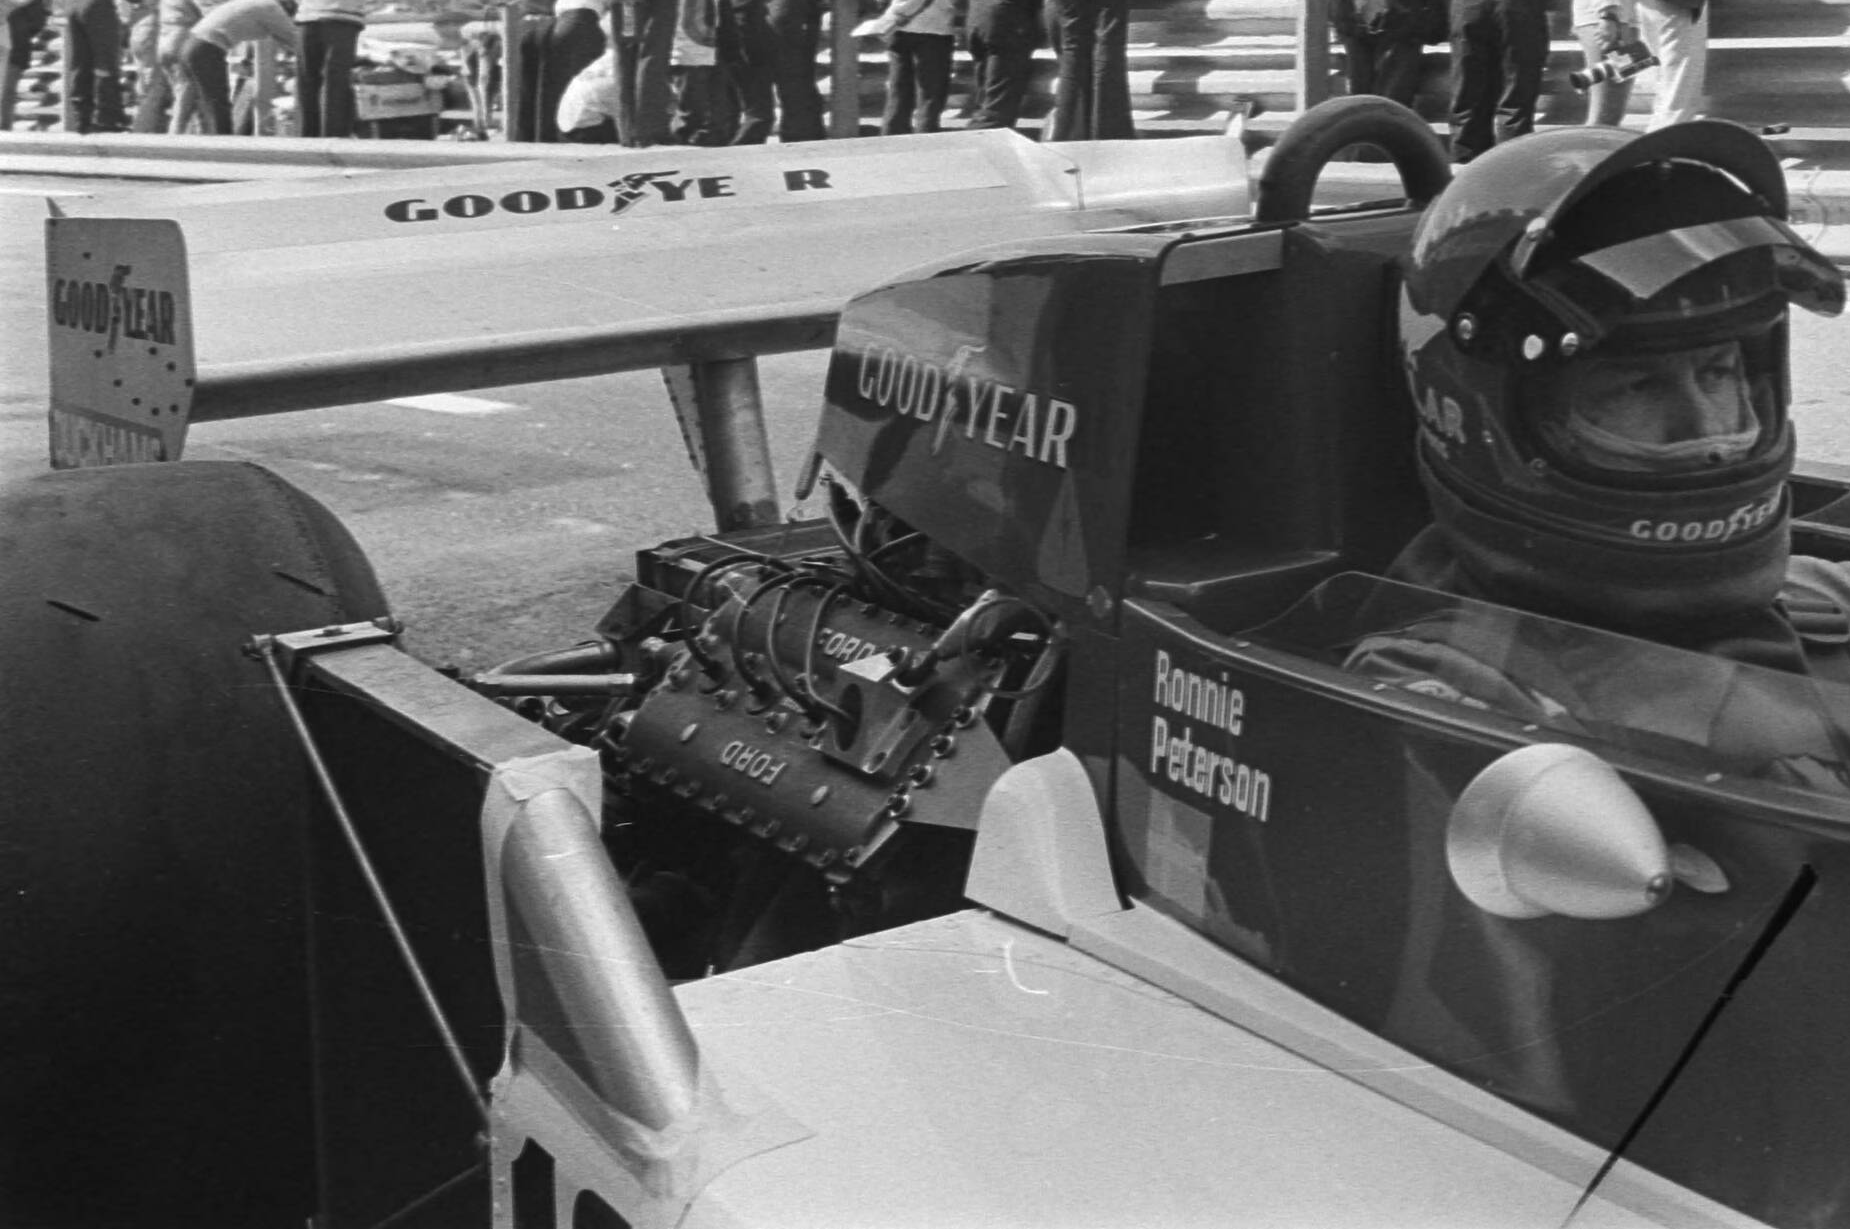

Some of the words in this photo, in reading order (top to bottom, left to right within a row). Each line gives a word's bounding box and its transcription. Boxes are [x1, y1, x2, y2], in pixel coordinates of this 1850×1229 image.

[53, 264, 177, 354] GOODYEAR
[859, 344, 1077, 469] GOODYEAR
[1155, 649, 1243, 736] Ronnie
[720, 740, 788, 785] FORD
[1152, 715, 1269, 822] Peterson
